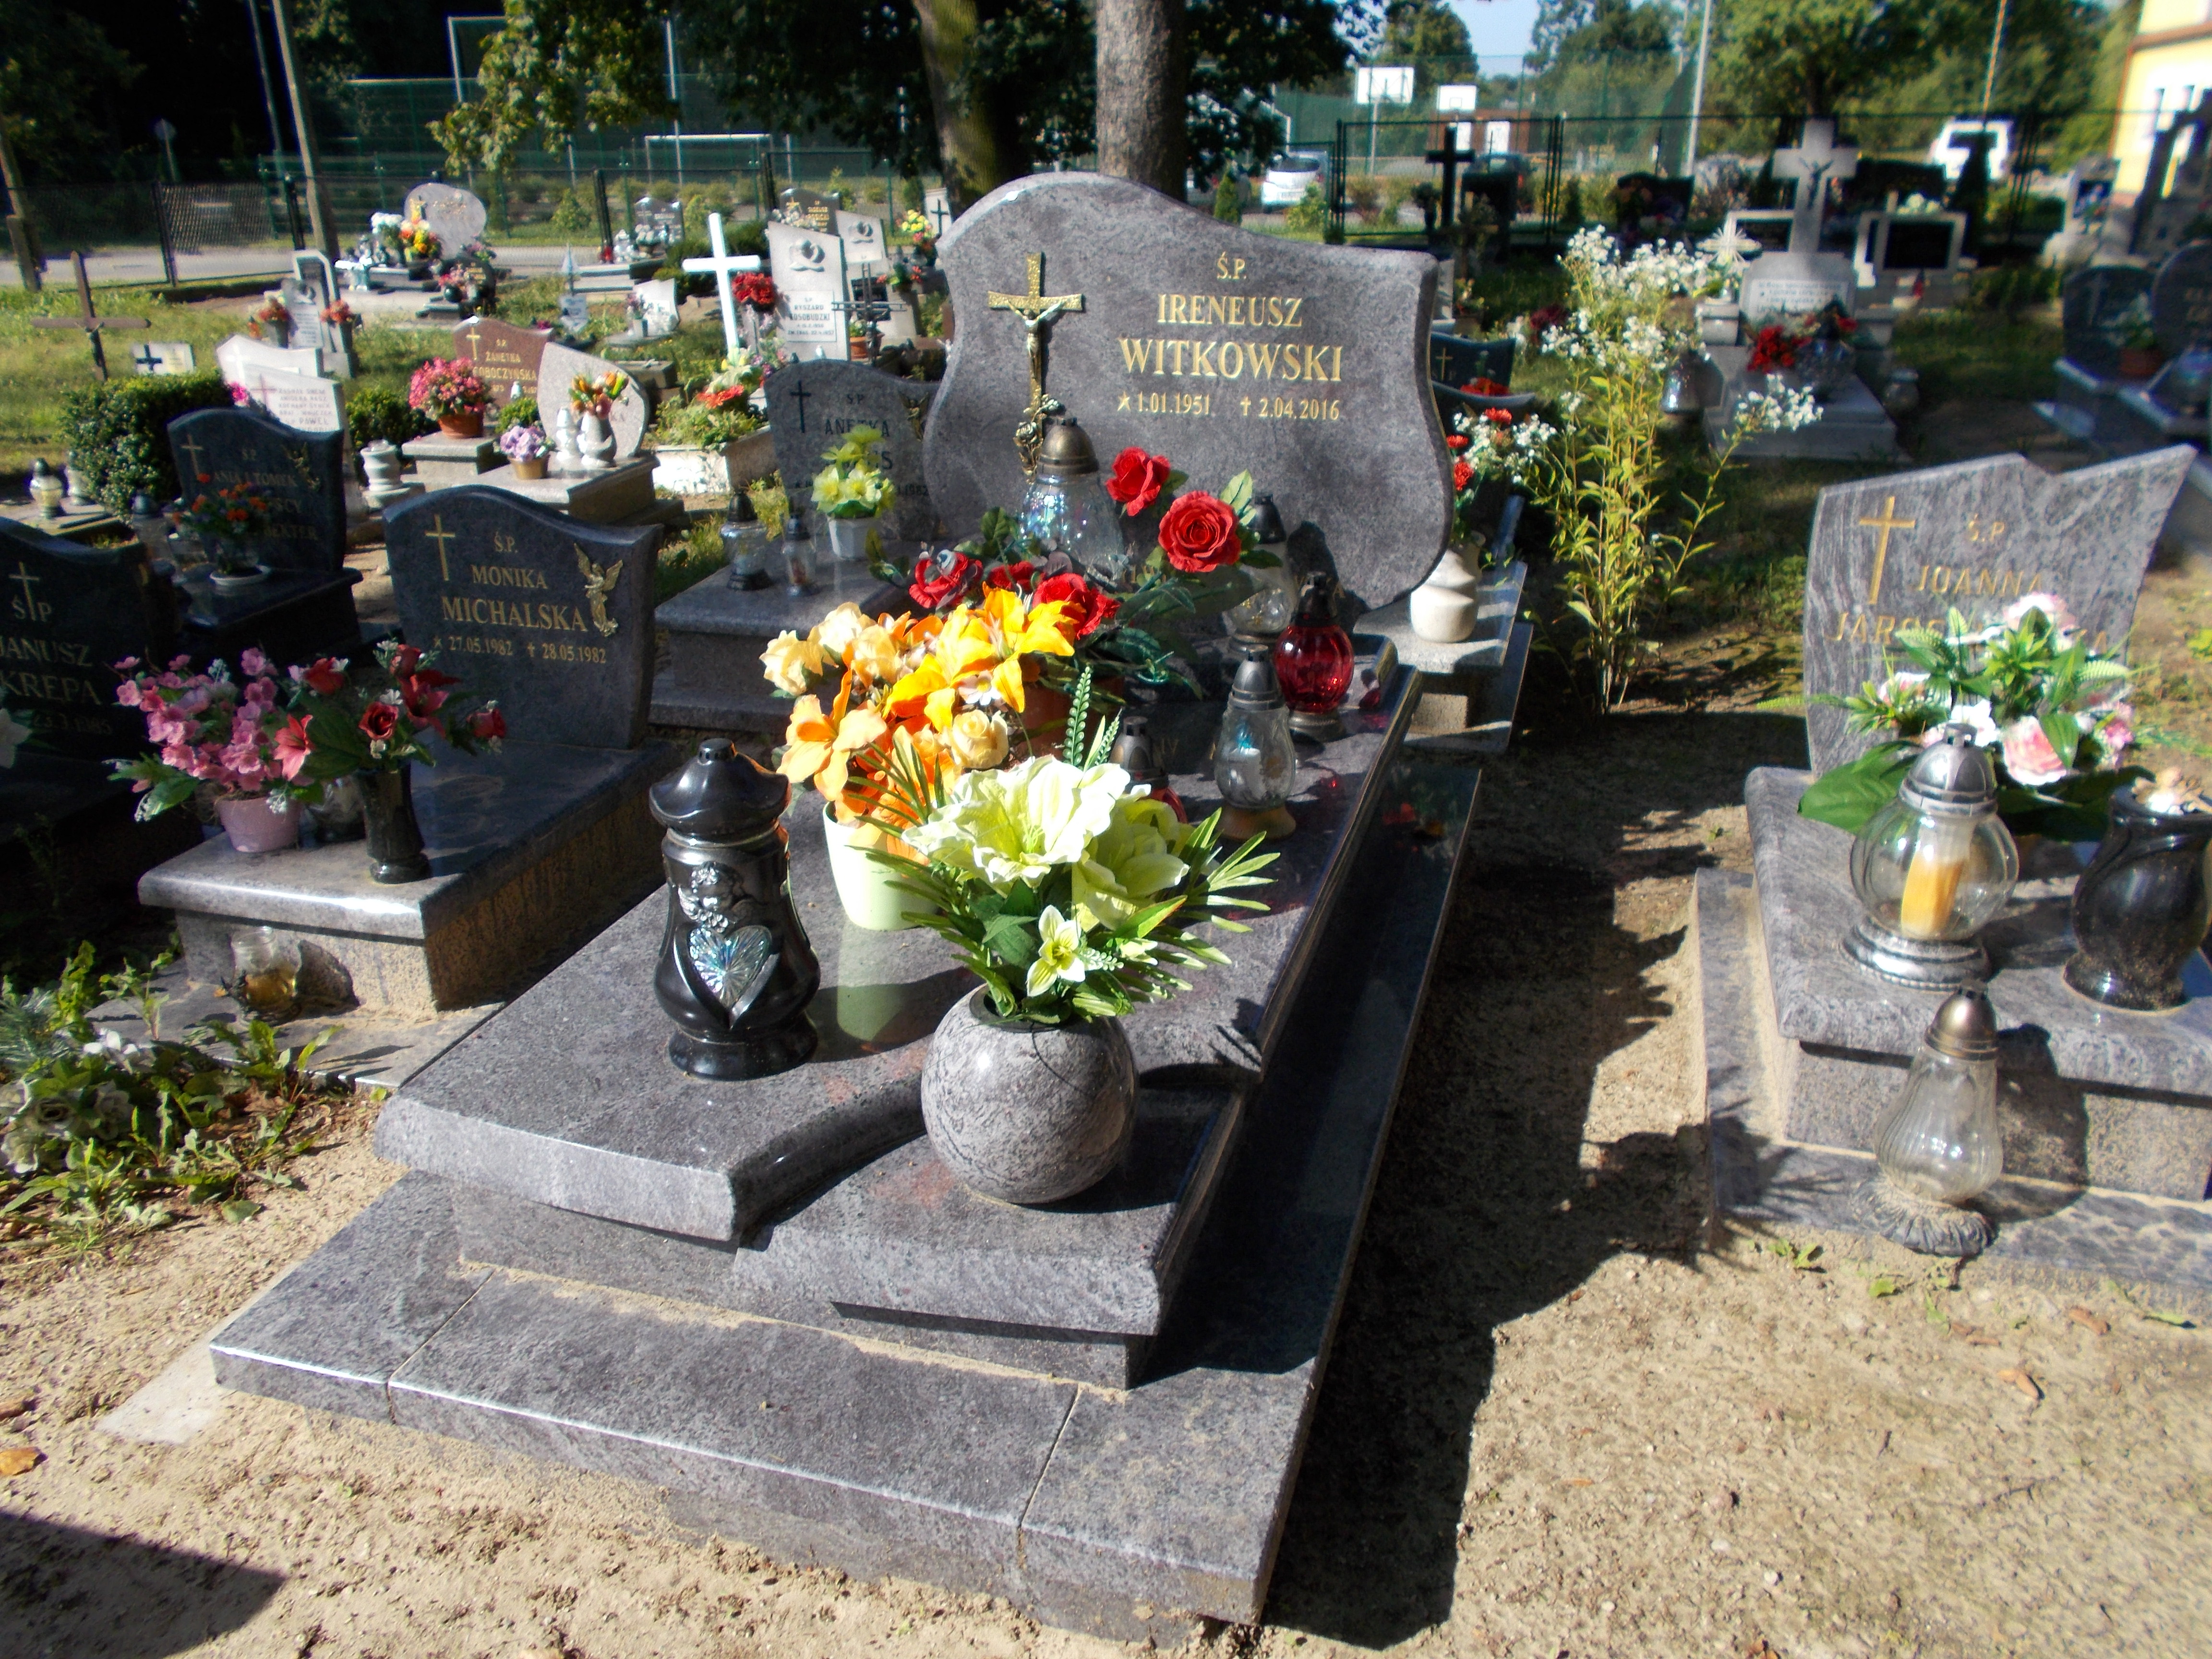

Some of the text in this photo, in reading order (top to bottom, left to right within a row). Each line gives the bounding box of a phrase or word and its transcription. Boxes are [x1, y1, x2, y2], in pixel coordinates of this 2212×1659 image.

[1157, 293, 1303, 327] IRENEUSZ
[1117, 338, 1343, 382] WITKOWSKI
[1137, 391, 1340, 421] 1.01.1951 2.04.2016
[825, 418, 889, 437] ANEA
[470, 564, 548, 589] MONIKA
[1910, 564, 2043, 595] JOANNA
[441, 596, 588, 632] MICHALSKA
[448, 636, 607, 664] 27.05.1982 28.05.1982
